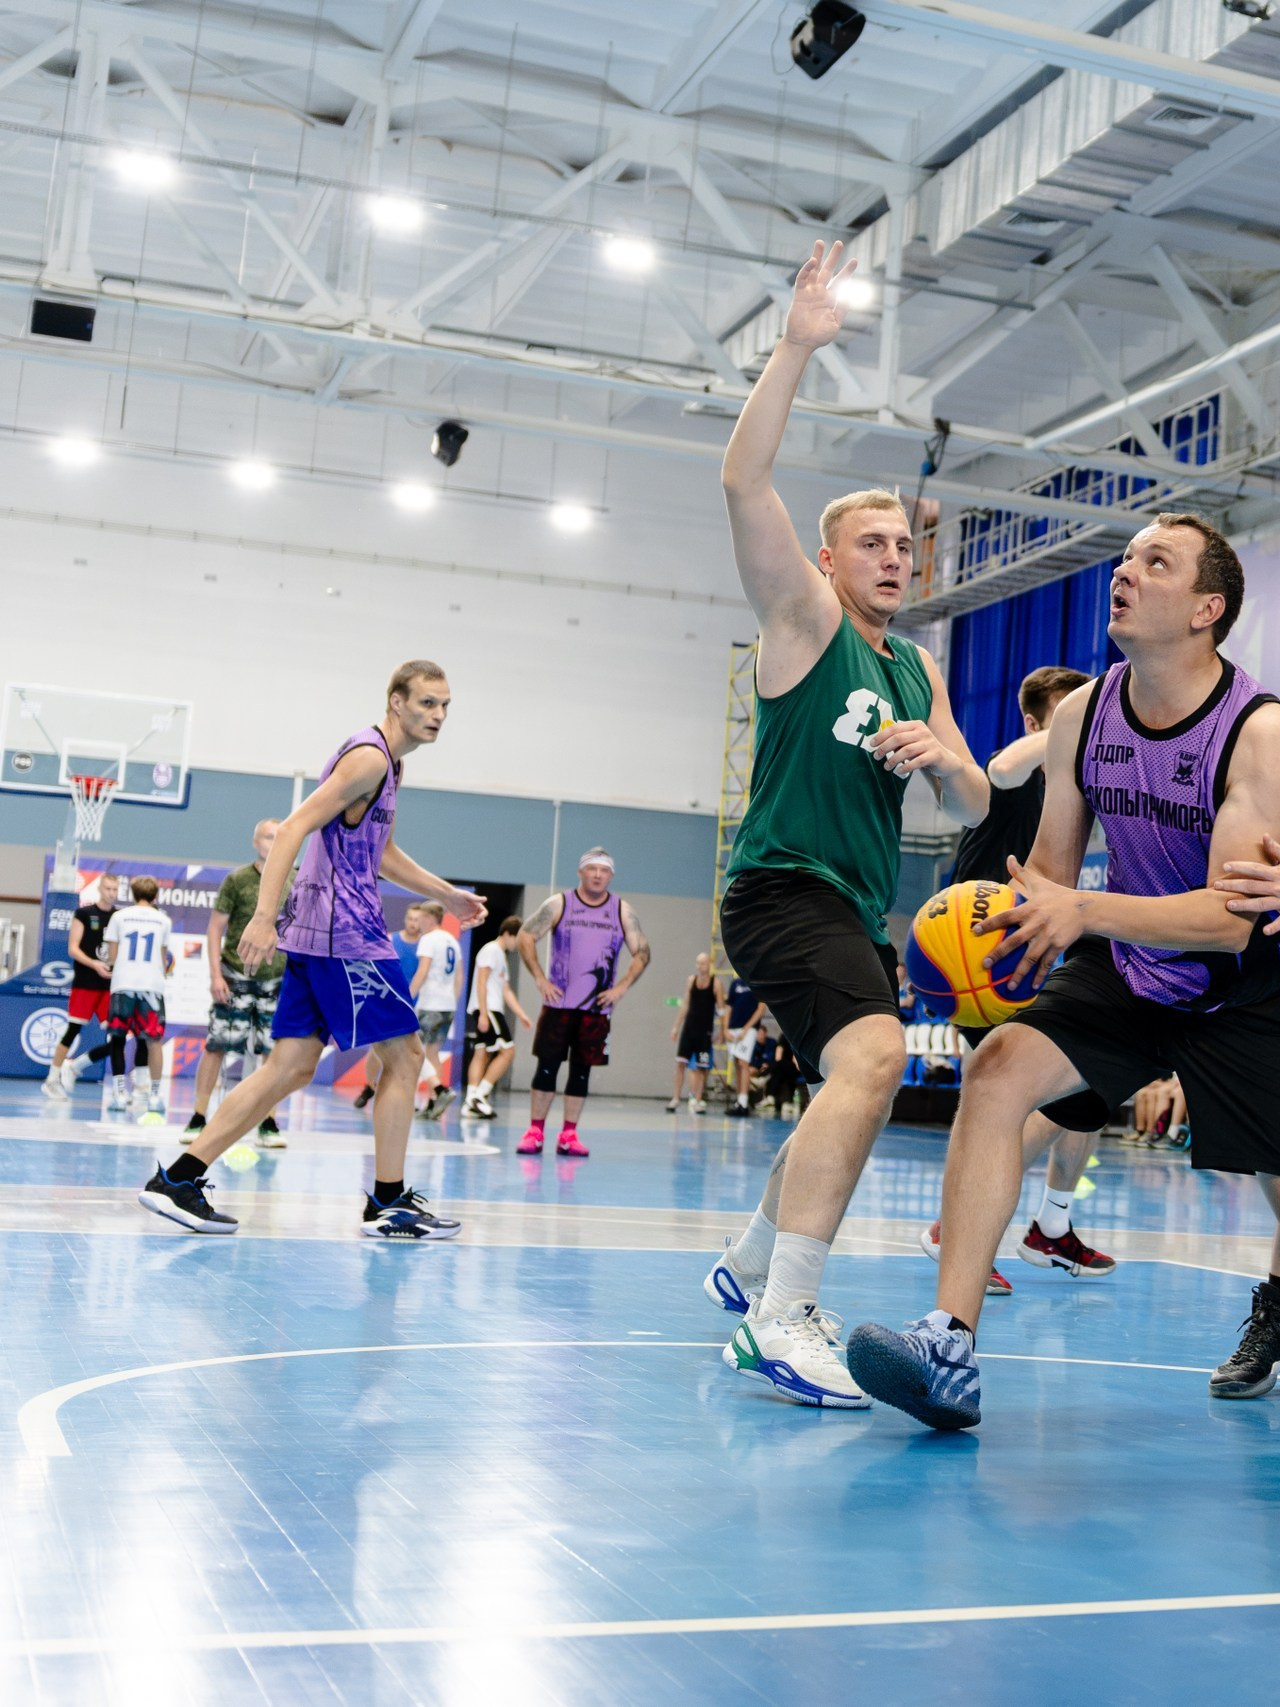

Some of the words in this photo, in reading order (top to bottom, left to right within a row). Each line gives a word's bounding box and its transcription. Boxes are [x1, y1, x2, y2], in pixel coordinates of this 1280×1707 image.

[1091, 743, 1135, 765] ЛДПР
[1086, 784, 1140, 818] ОКОЛЫ
[1141, 791, 1213, 834] ПРИМОРЬ
[124, 931, 155, 962] 11
[445, 947, 456, 975] 9
